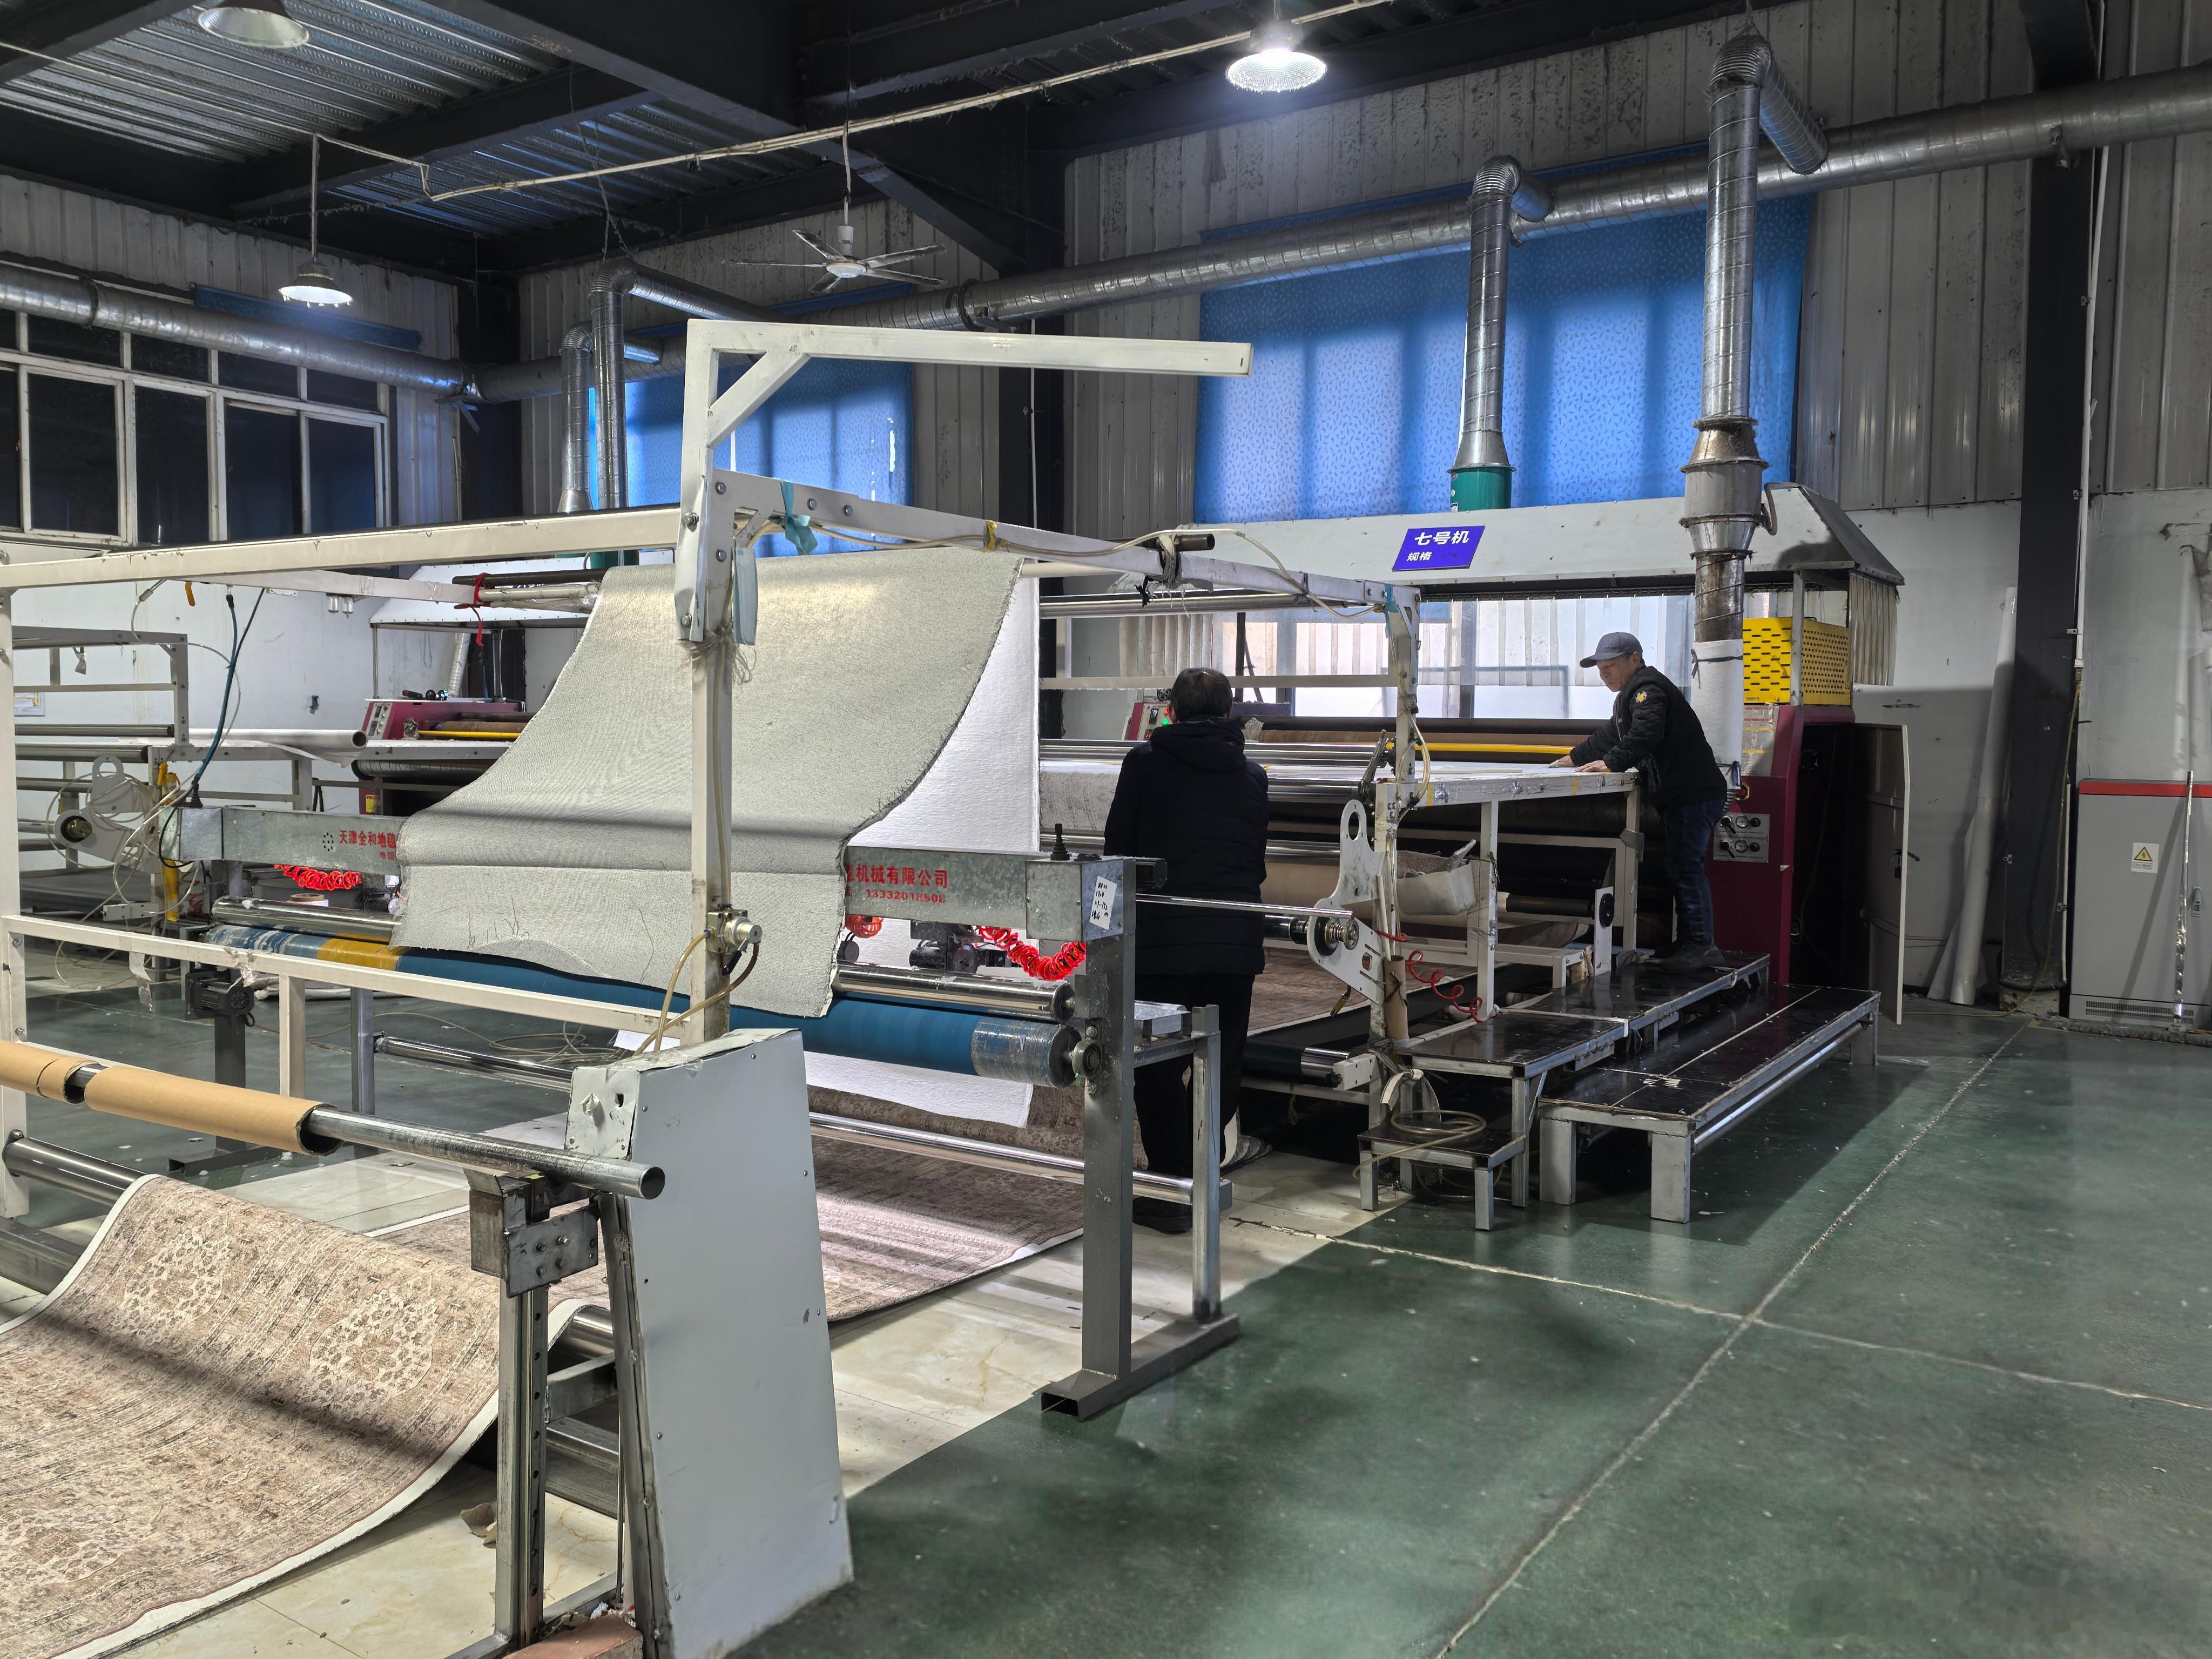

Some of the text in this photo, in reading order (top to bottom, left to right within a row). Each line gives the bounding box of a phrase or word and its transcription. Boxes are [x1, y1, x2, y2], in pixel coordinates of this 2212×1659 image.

[1414, 530, 1469, 545] 七号机
[1406, 551, 1433, 562] 规格
